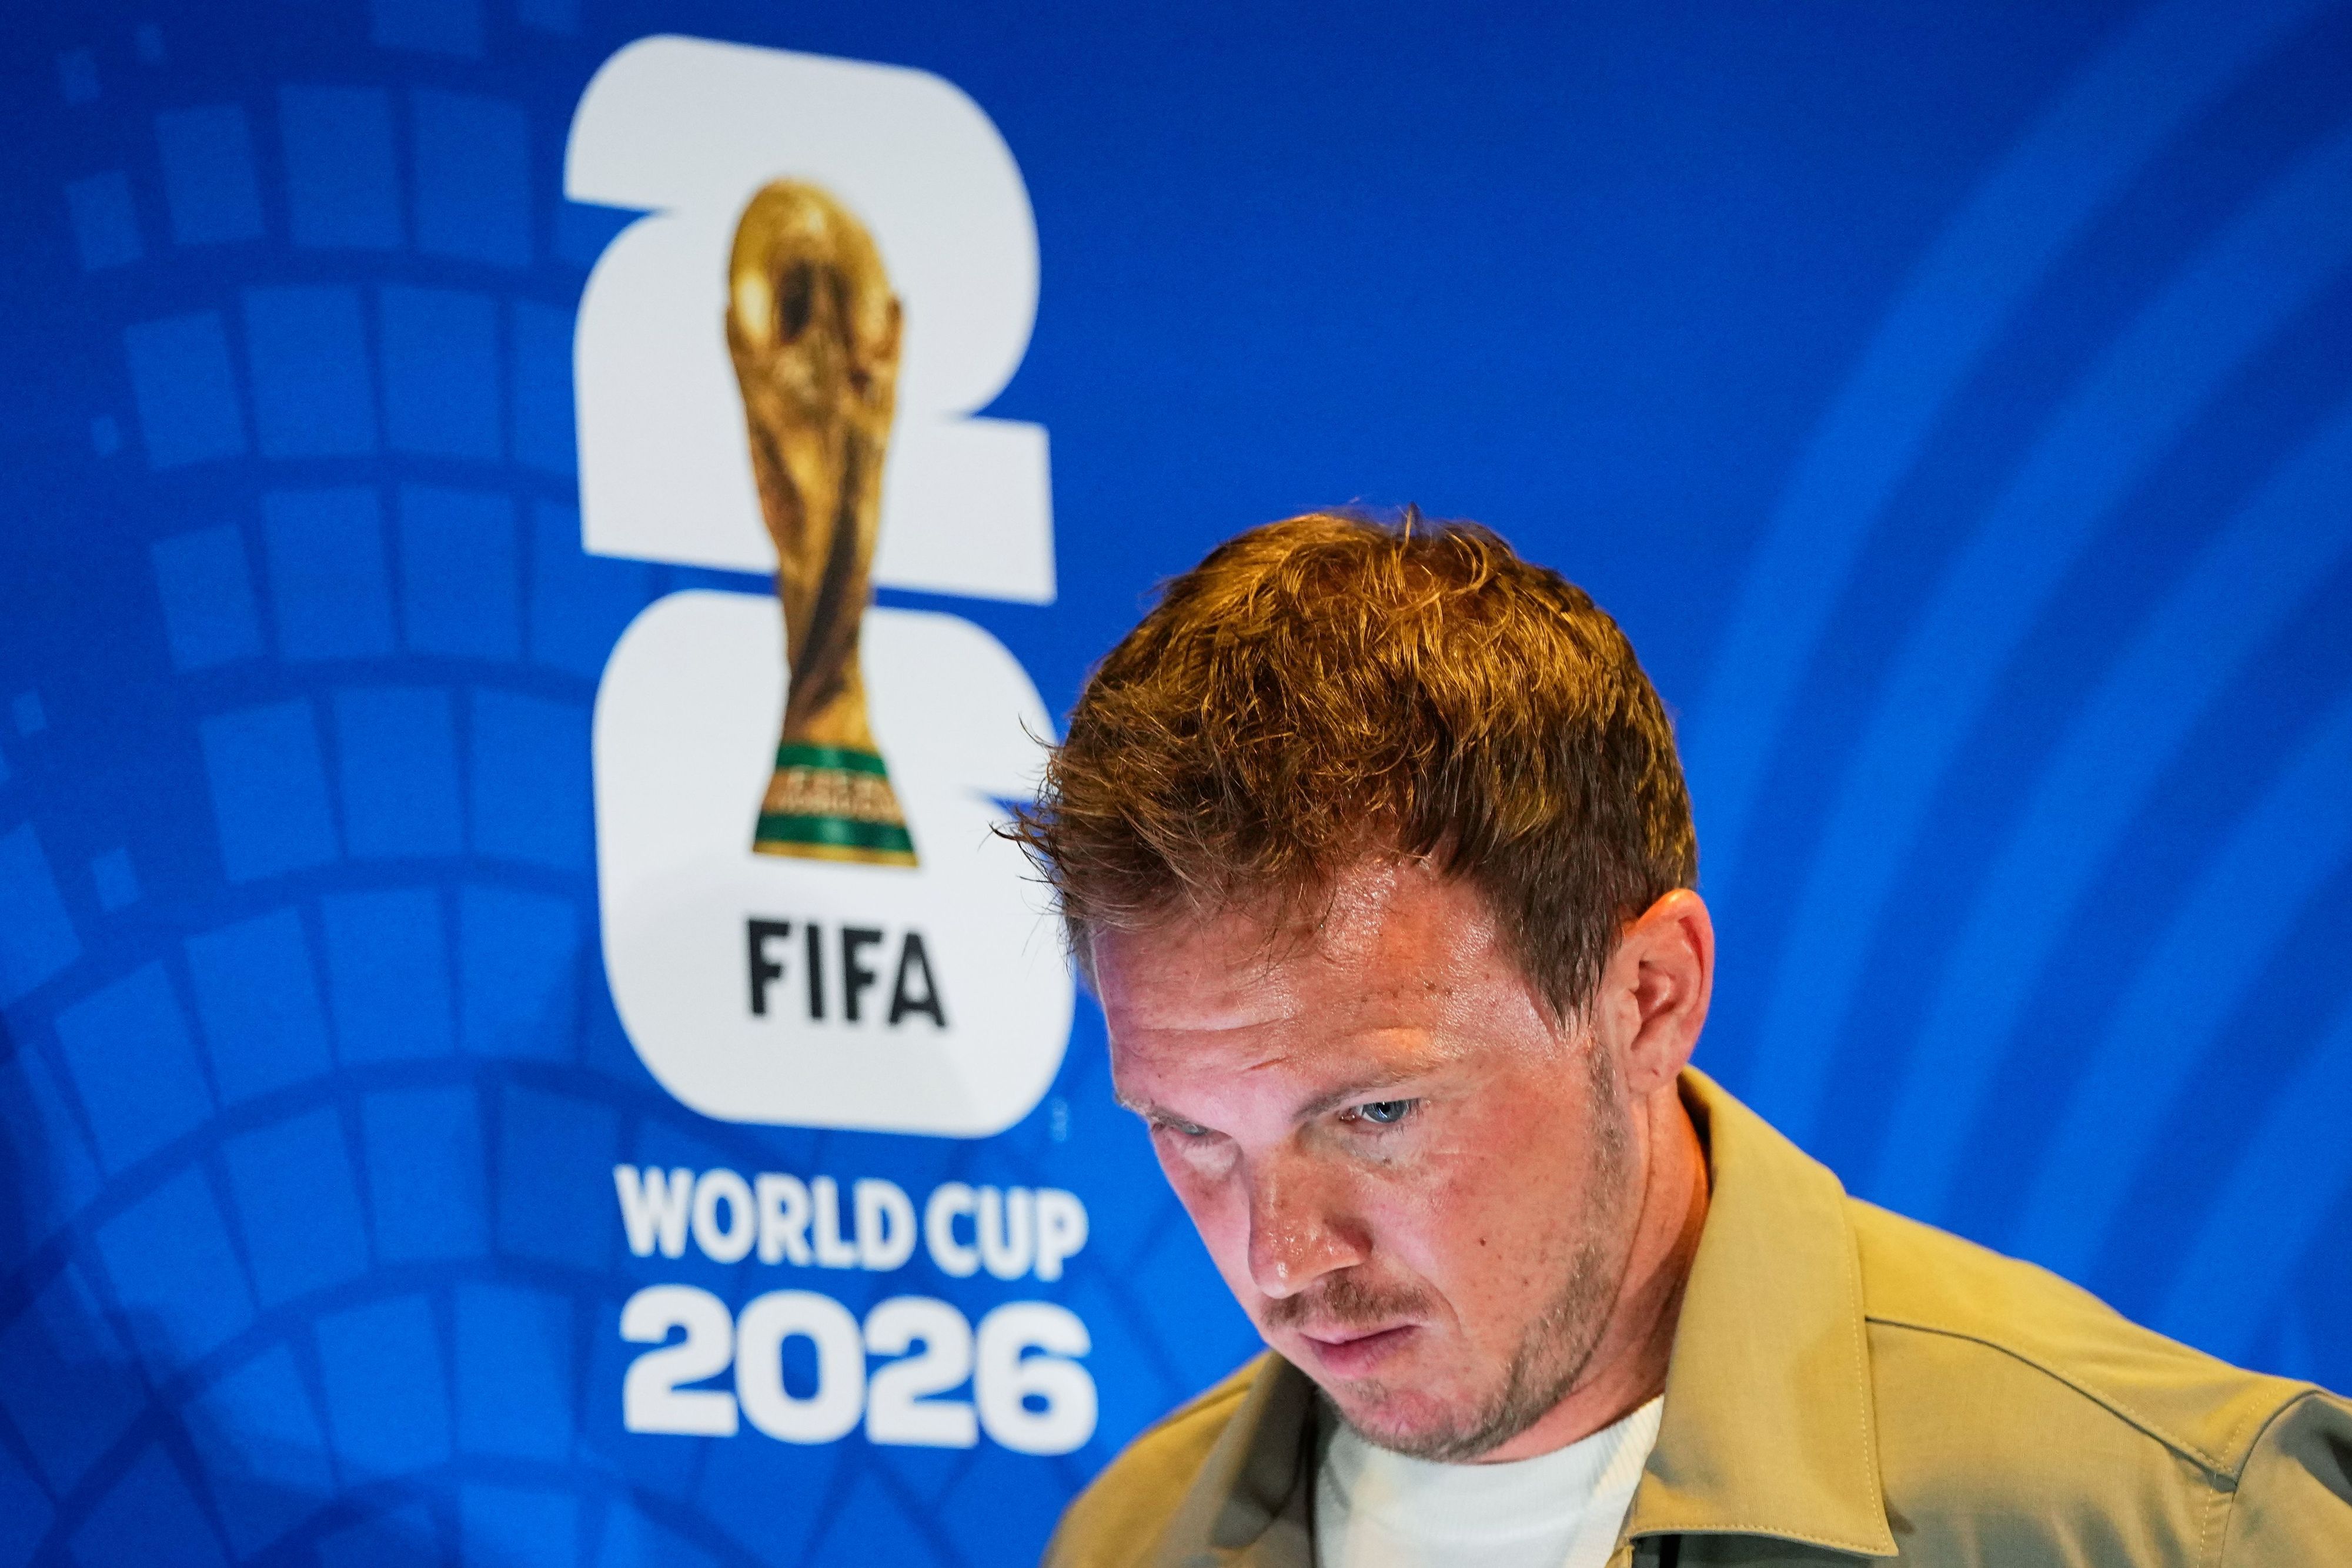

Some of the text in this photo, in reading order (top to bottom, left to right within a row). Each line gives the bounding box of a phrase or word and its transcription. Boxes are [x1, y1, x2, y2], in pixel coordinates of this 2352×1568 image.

[746, 917, 947, 1029] FIFA
[614, 1165, 1088, 1281] WORLD CUP
[620, 1285, 1098, 1455] 2026
